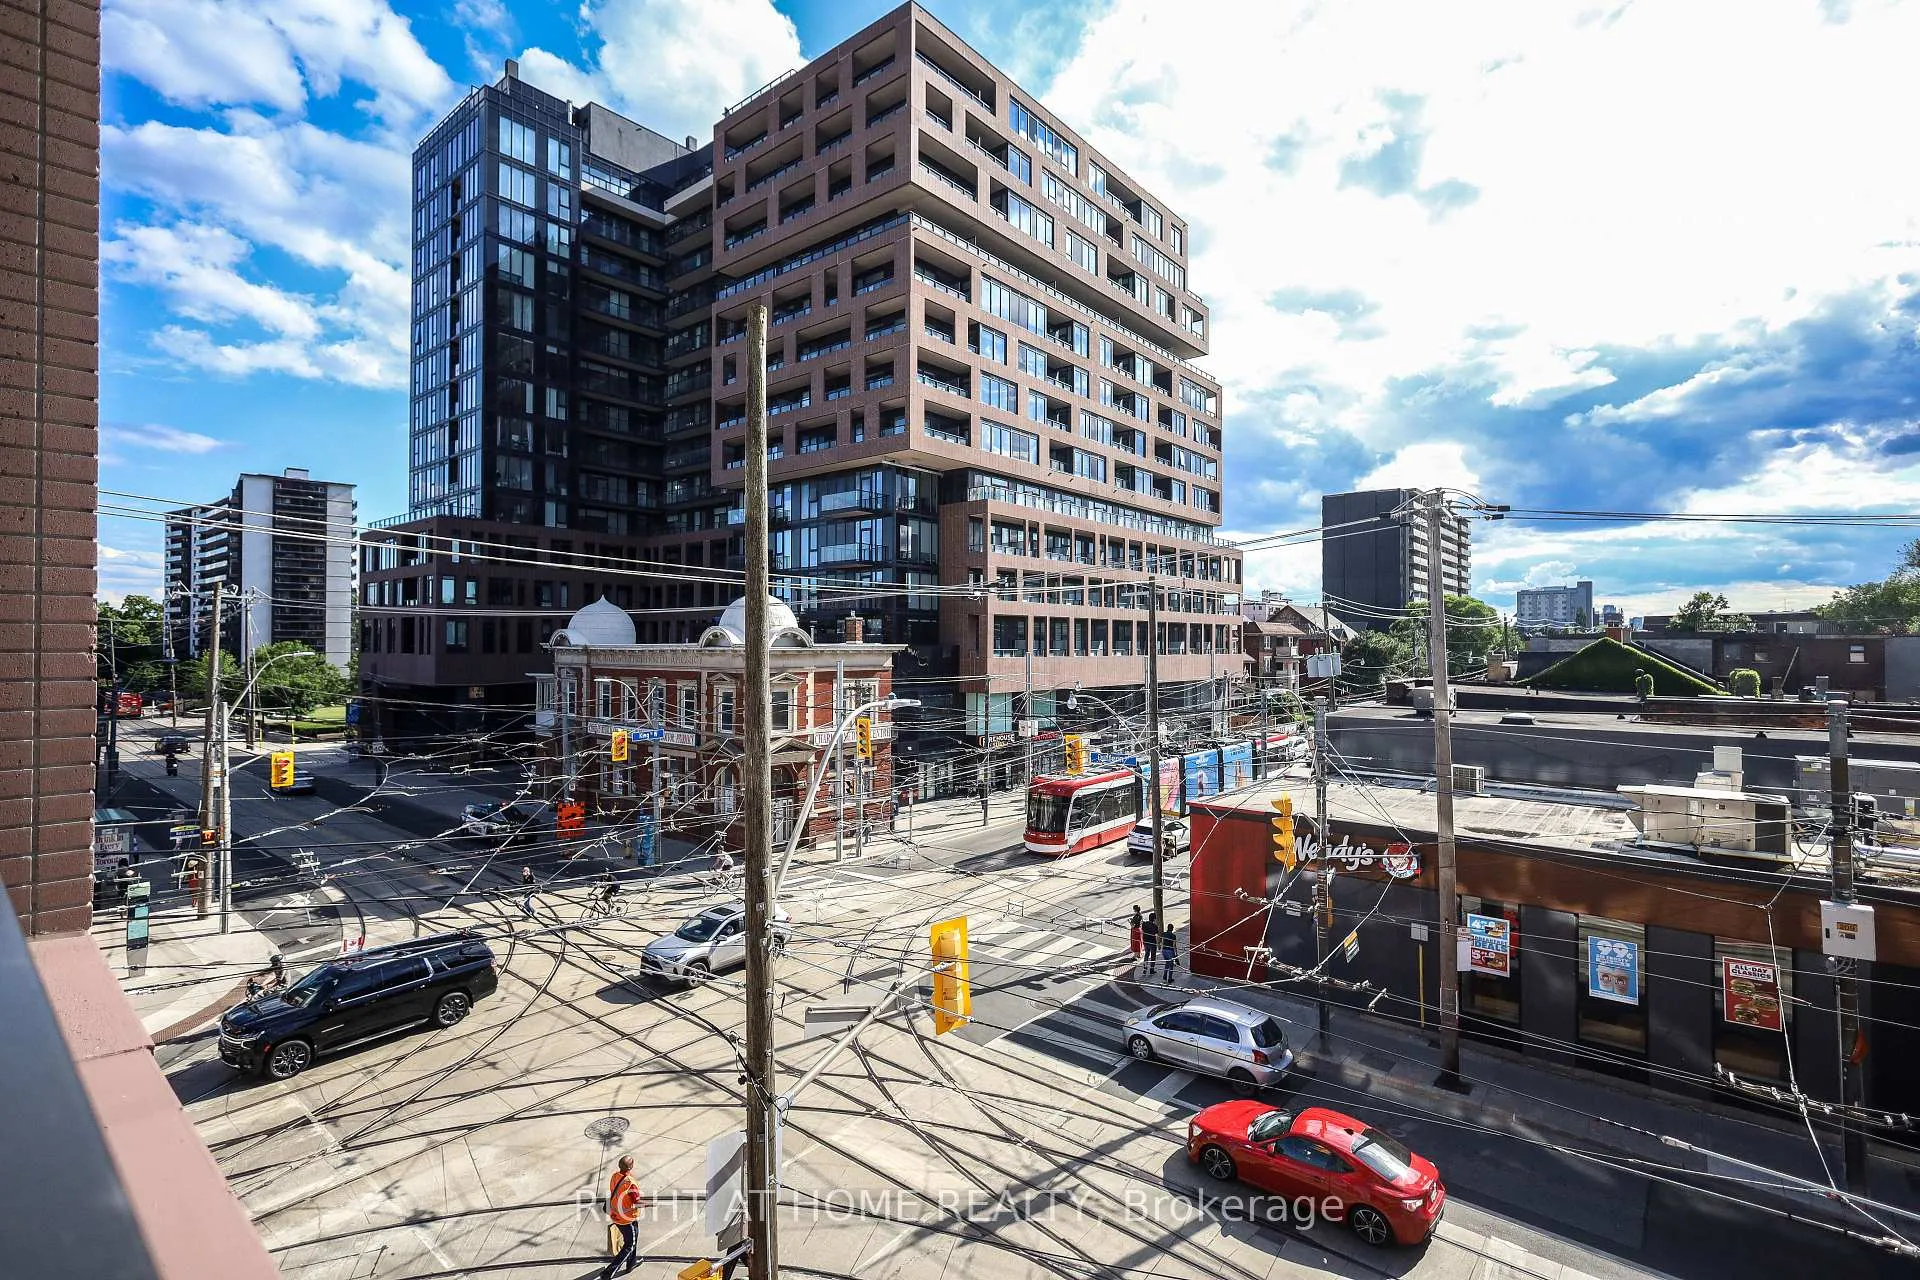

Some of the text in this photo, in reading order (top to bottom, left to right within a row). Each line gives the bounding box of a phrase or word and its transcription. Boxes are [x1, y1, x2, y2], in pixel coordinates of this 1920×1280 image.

[982, 734, 1015, 747] FREHOUSE
[1731, 968, 1772, 980] CLASSICS
[1734, 964, 1768, 974] ALL-DAY
